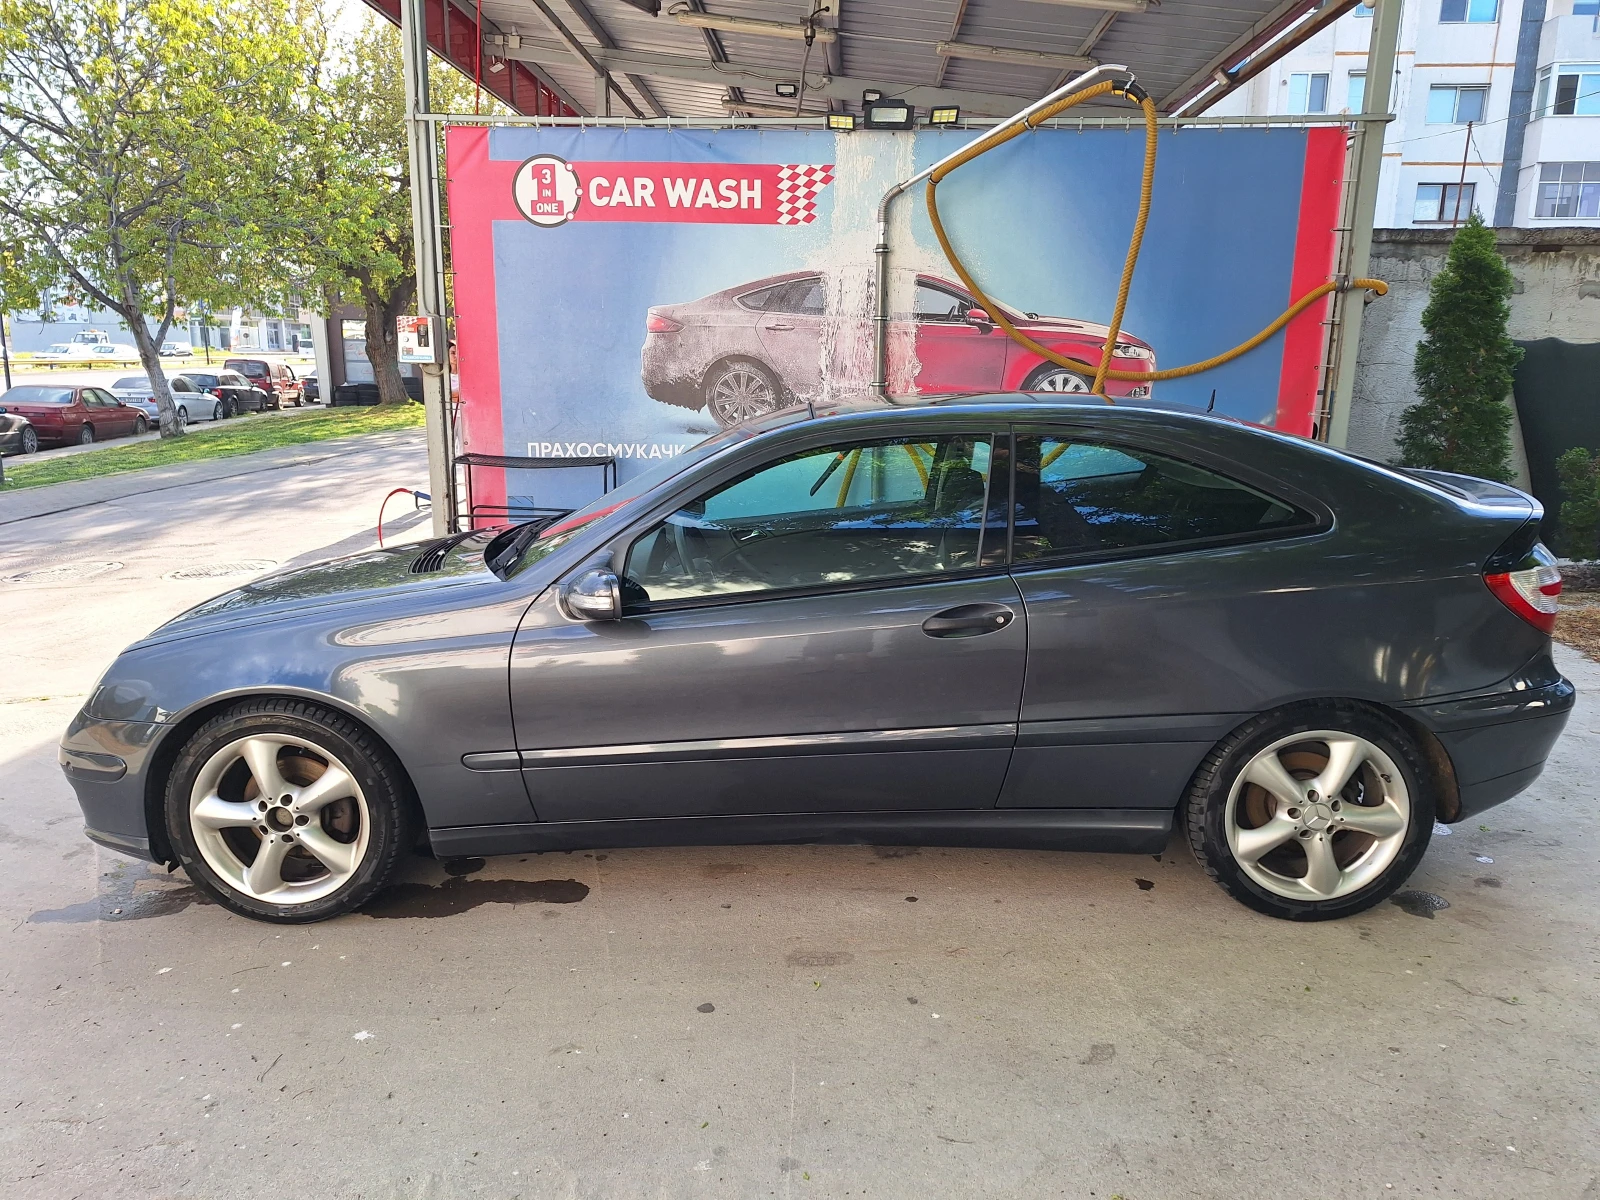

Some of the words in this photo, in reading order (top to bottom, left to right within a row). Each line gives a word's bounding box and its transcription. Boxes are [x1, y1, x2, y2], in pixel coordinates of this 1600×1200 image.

[541, 168, 552, 185] 3
[542, 189, 552, 198] IN
[588, 176, 656, 207] CAR
[662, 177, 762, 210] WASH
[536, 202, 559, 213] ONE
[527, 442, 696, 460] ПРАХОСМУКАЧК
